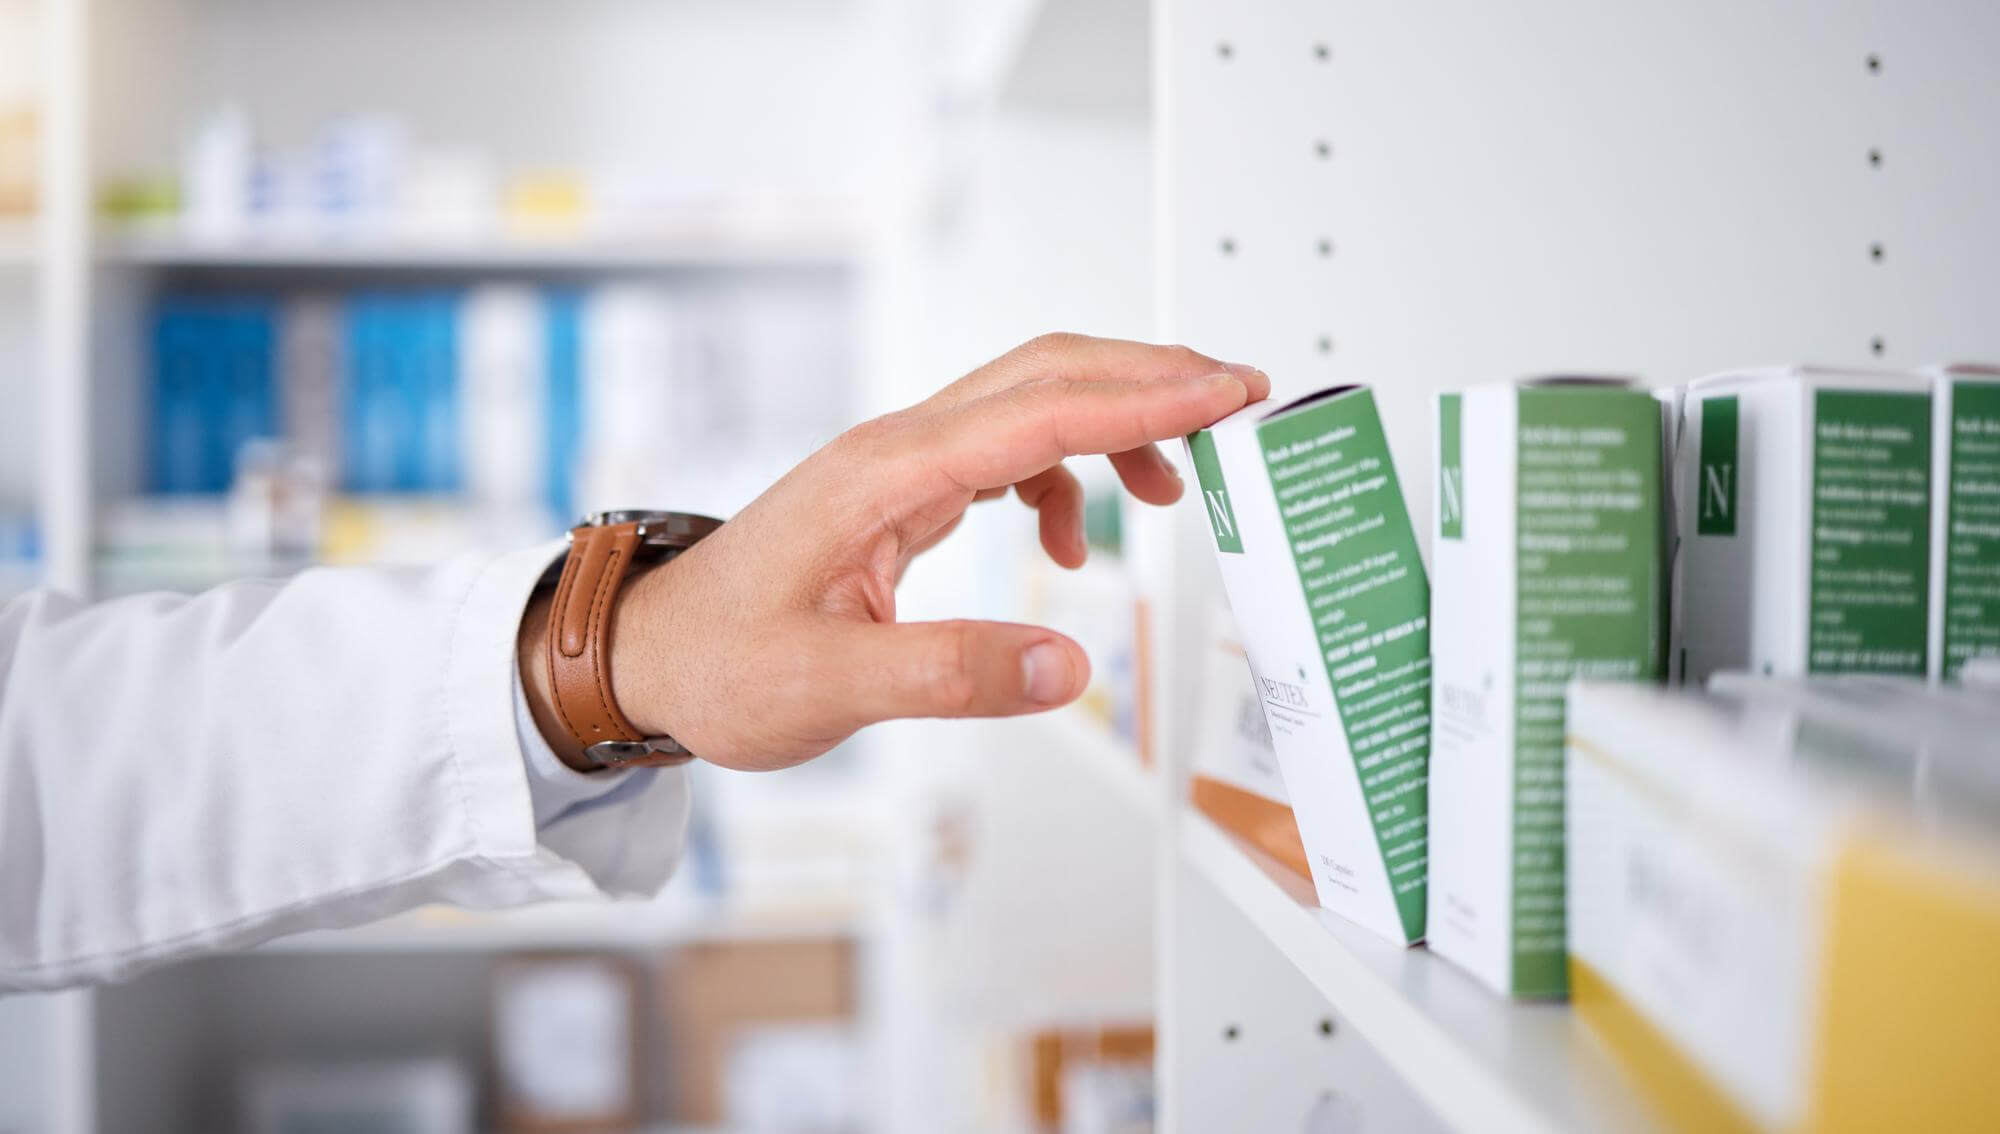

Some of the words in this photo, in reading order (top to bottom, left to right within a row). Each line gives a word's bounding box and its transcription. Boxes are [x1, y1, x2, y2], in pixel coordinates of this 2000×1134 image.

[1205, 490, 1234, 538] N
[1704, 464, 1732, 519] N
[1260, 676, 1308, 708] NEUTEX
